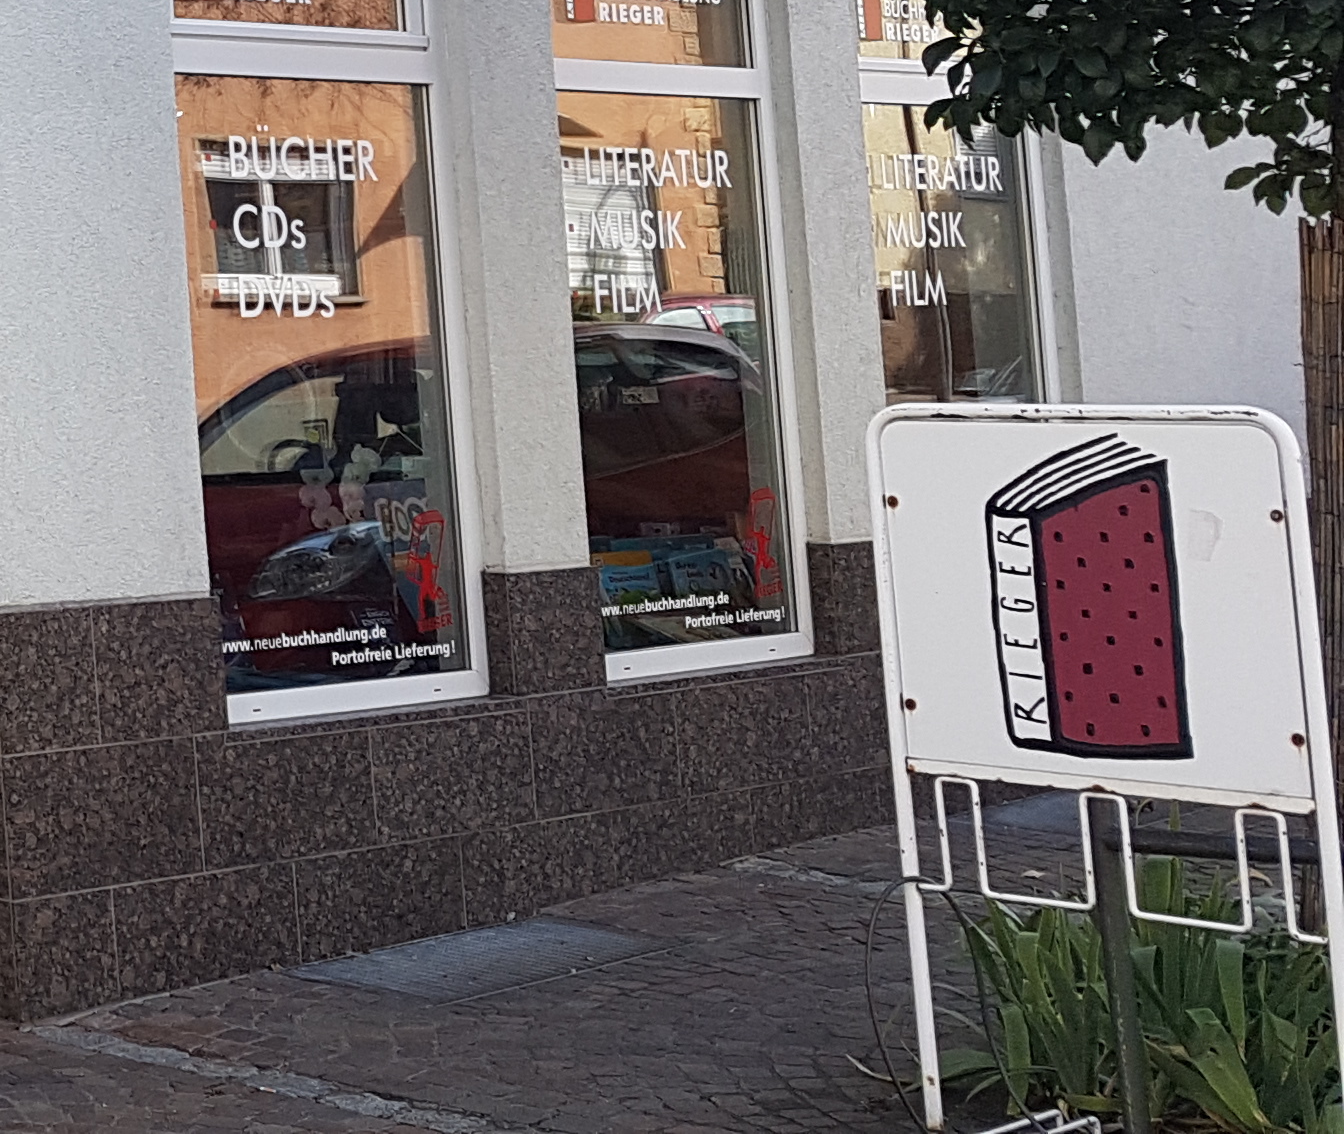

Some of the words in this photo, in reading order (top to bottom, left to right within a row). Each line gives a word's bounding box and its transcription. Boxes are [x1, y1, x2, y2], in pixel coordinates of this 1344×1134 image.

[599, 1, 665, 26] RIEGER
[228, 124, 378, 182] BÜCHER
[584, 146, 732, 188] LITERATUR
[881, 153, 1004, 192] LITERATUR
[232, 203, 306, 249] CDs
[589, 209, 686, 250] MUSIK
[886, 211, 967, 249] MUSIK
[237, 274, 336, 319] DVDs
[594, 274, 663, 314] FILM
[890, 270, 948, 307] FILM
[601, 591, 730, 617] ww.neuebuchhandlung.de
[685, 611, 734, 628] Portofreie
[996, 521, 1046, 726] RIEGER
[332, 644, 392, 665] Portofreie
